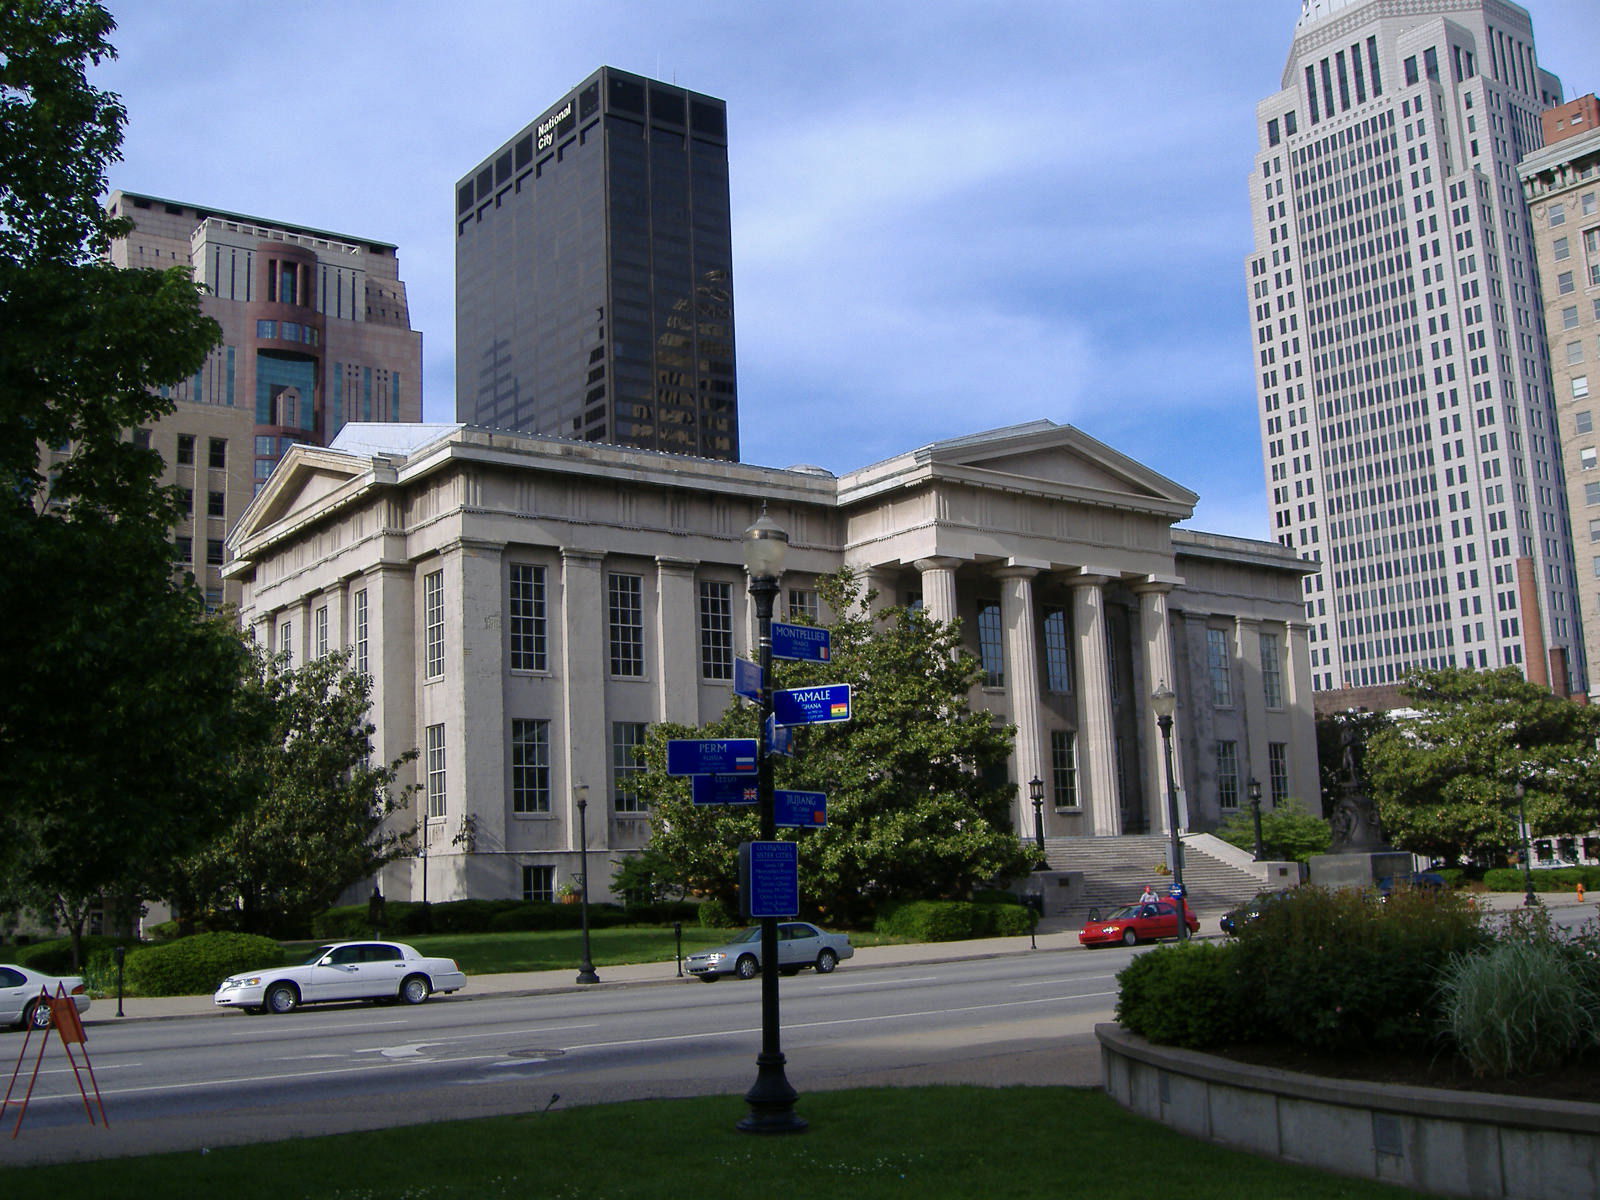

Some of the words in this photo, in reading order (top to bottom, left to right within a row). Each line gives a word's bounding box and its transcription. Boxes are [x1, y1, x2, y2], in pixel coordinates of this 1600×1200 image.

[538, 102, 571, 138] National
[538, 132, 553, 150] City
[775, 626, 826, 641] MONTPELLIER
[792, 690, 831, 703] TAMALE
[699, 743, 728, 753] PERM
